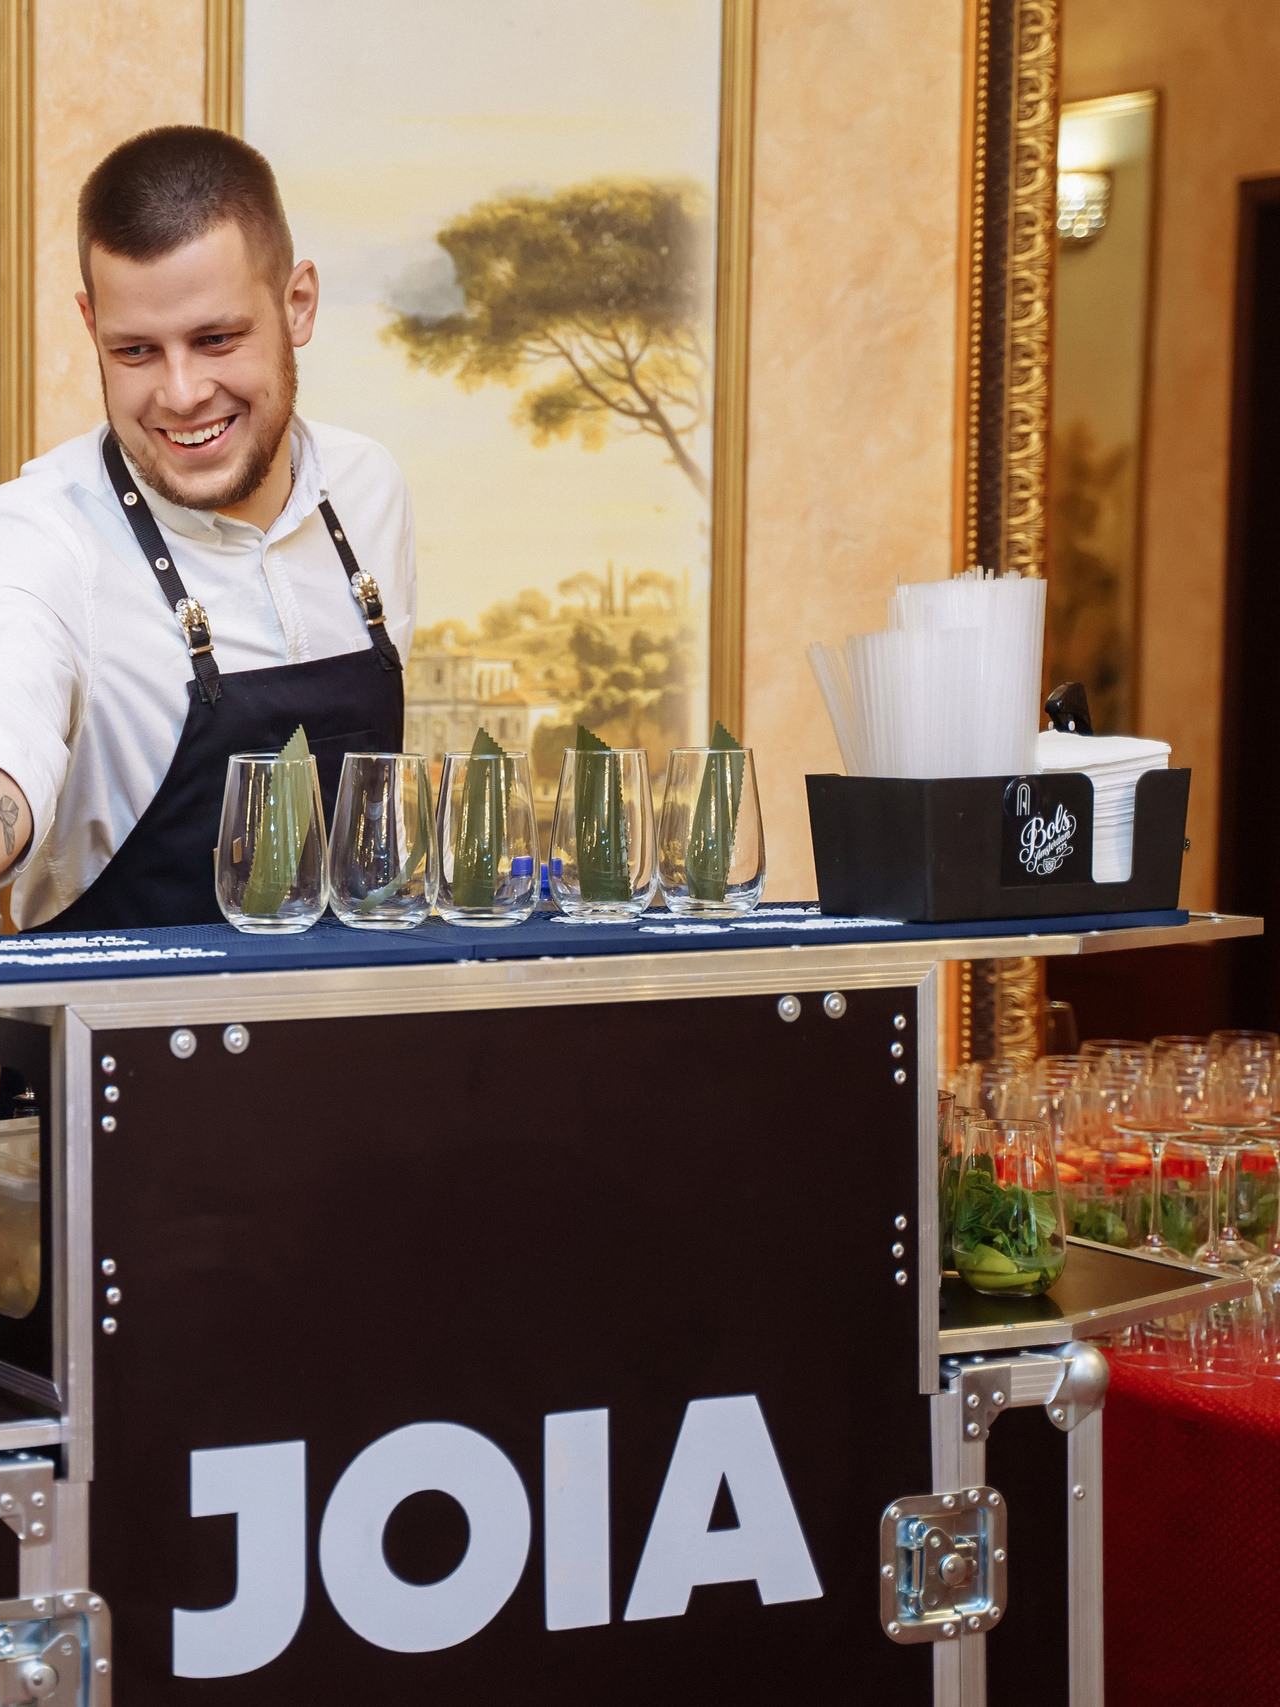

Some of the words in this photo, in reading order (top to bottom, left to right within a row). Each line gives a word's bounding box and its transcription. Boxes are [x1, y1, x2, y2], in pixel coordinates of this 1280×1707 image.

[1019, 804, 1076, 864] Bols
[1026, 830, 1071, 872] Amsterdam
[172, 1394, 824, 1679] JOIA
